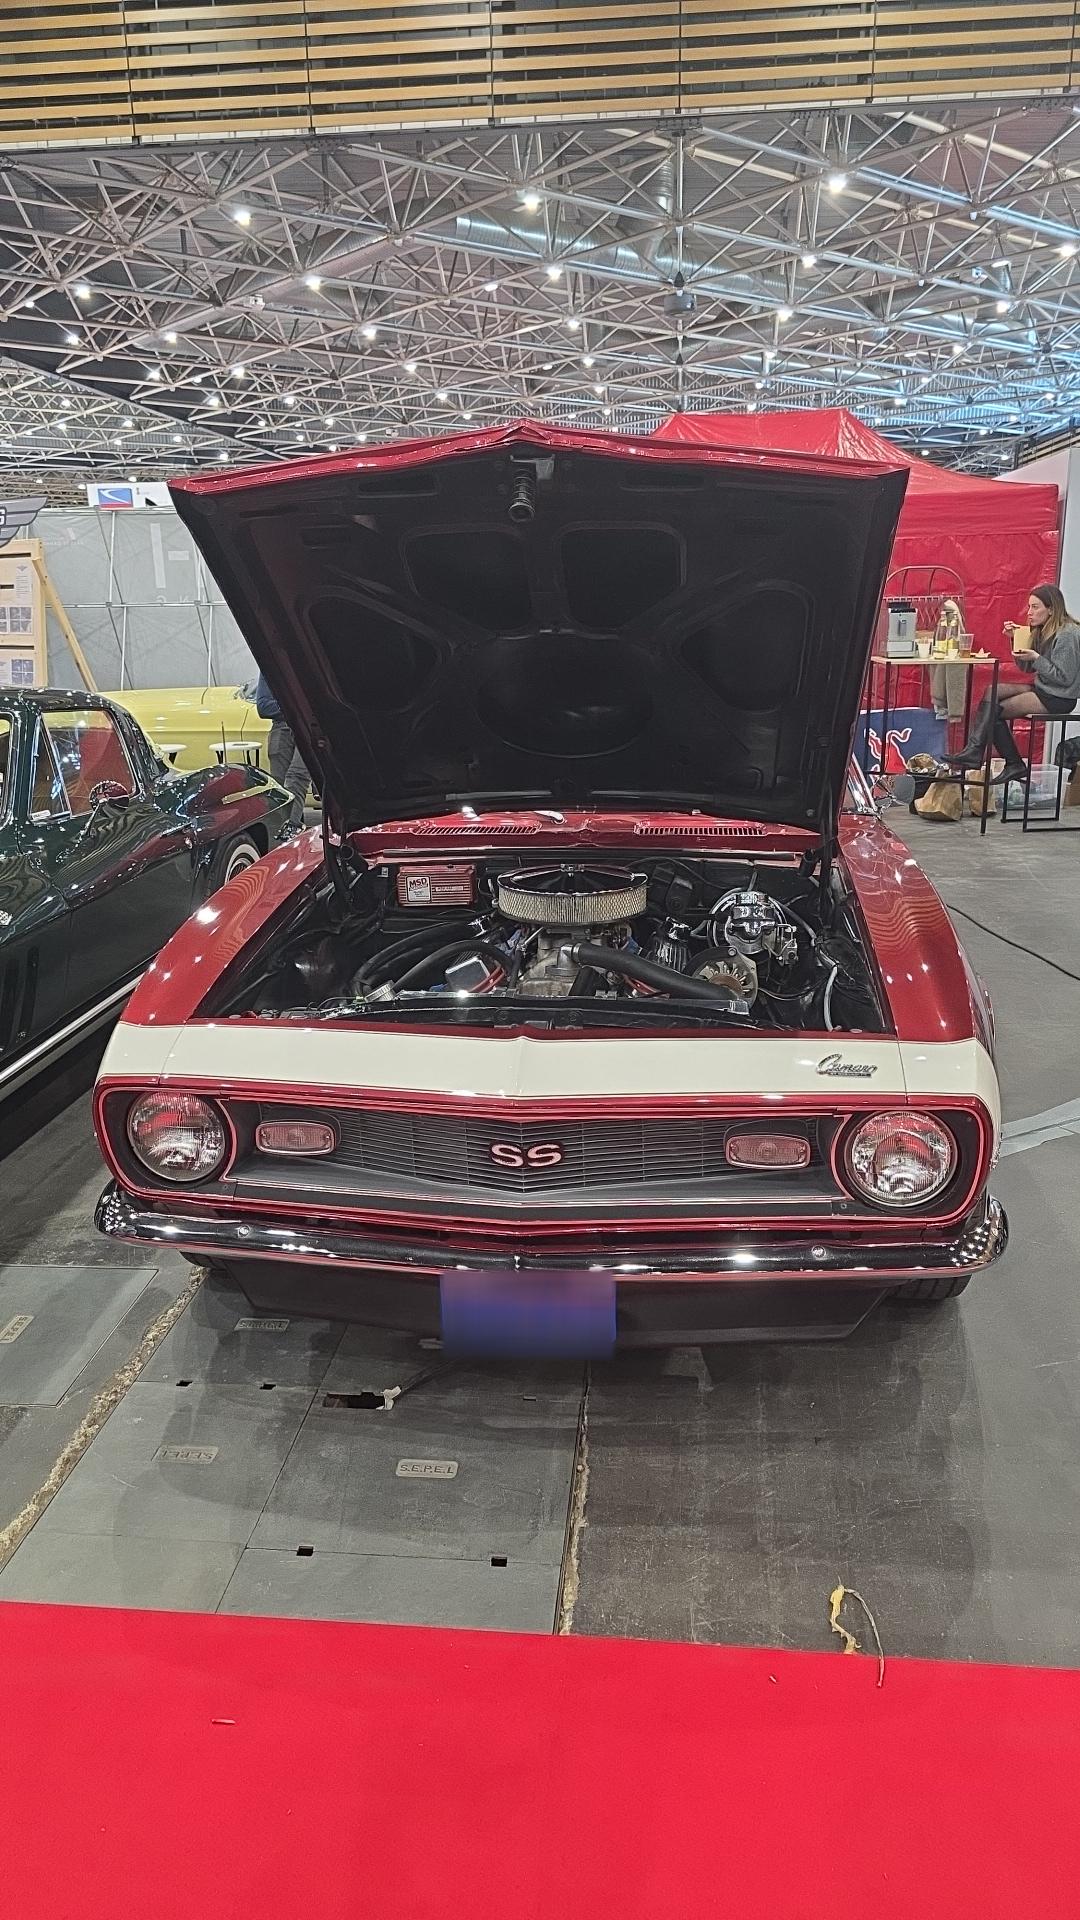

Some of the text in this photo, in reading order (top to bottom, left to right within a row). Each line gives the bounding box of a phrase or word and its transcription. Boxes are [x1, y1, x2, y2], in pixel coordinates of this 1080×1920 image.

[409, 877, 427, 888] MSD
[816, 1053, 878, 1075] Camaro
[491, 1143, 562, 1167] SS
